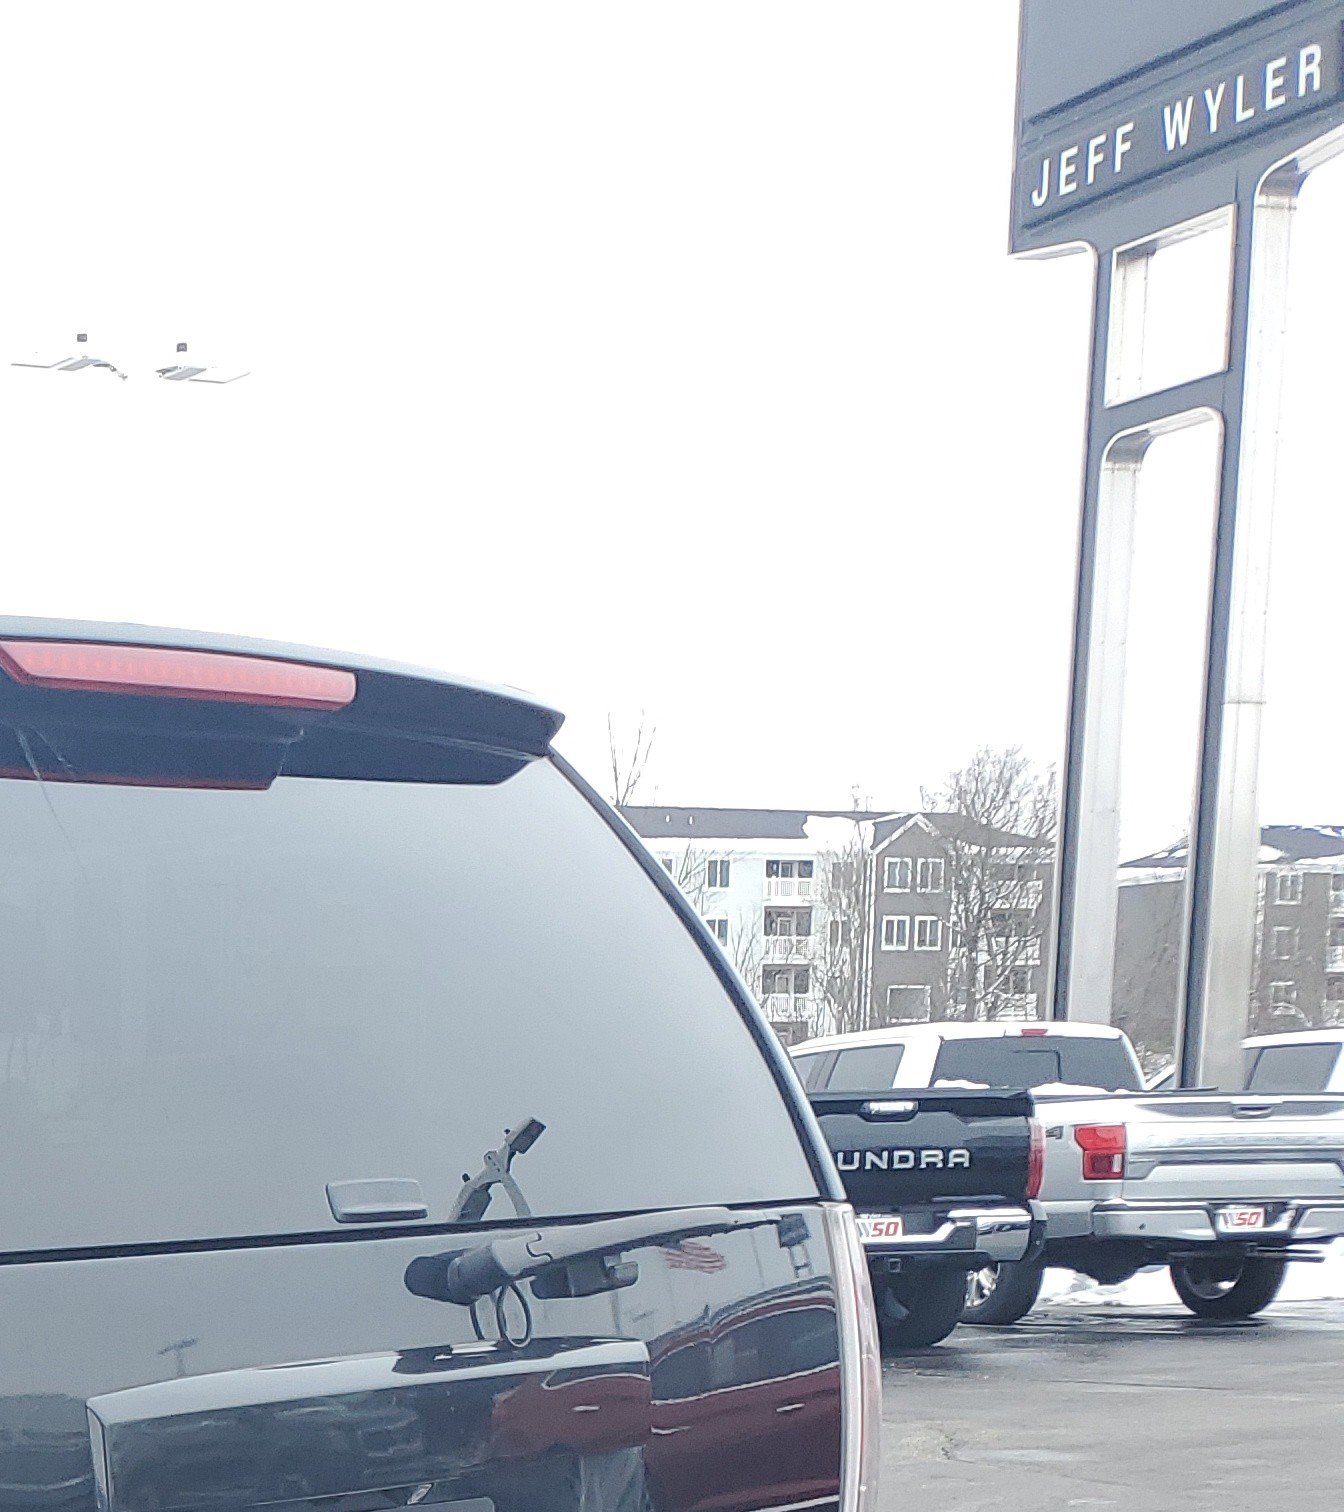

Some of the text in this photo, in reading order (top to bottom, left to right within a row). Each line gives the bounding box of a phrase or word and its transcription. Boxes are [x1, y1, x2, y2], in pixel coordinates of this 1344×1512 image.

[1030, 43, 1323, 208] JEFF WYLER
[836, 1148, 971, 1172] UNDRA
